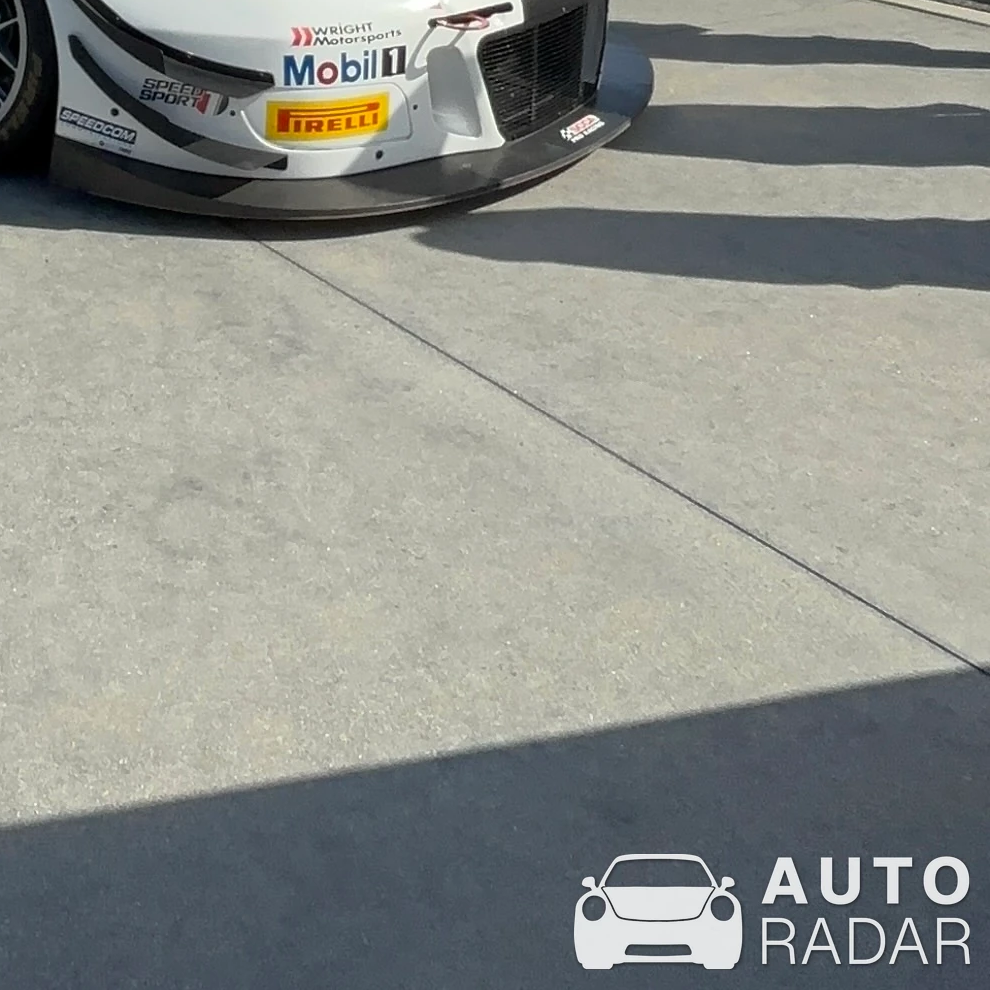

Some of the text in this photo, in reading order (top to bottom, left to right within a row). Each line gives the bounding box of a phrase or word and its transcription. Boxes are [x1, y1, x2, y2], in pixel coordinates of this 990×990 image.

[312, 22, 373, 36] WRIGHT
[313, 29, 401, 46] Motorsports
[283, 49, 377, 85] Mobil
[138, 90, 201, 108] SPORT
[60, 109, 136, 142] SPEEDCOM
[276, 102, 380, 134] PIRELLI
